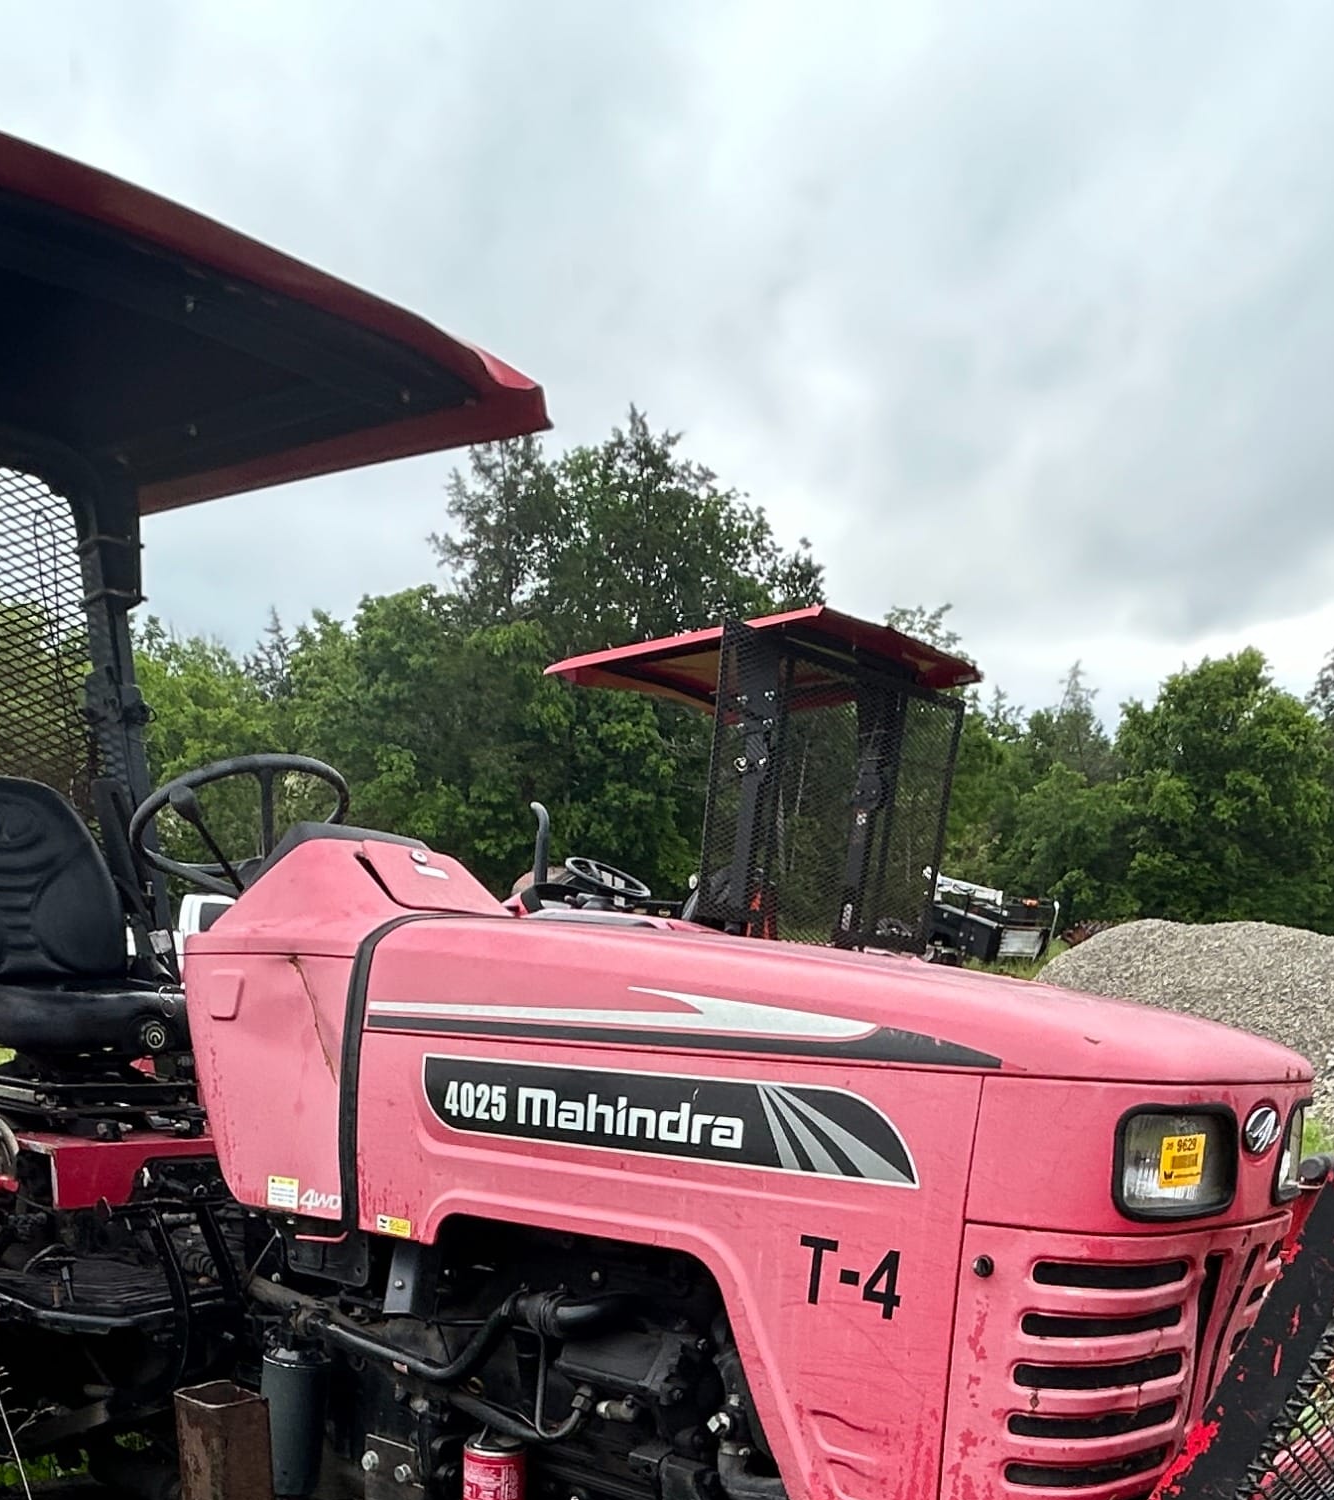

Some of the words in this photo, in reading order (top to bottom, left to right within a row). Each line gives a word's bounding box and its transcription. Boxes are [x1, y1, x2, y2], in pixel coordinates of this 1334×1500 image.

[444, 1080, 507, 1122] 4025
[517, 1086, 744, 1149] Mahindra
[299, 1188, 342, 1210] 4WD
[799, 1233, 902, 1321] T-4
